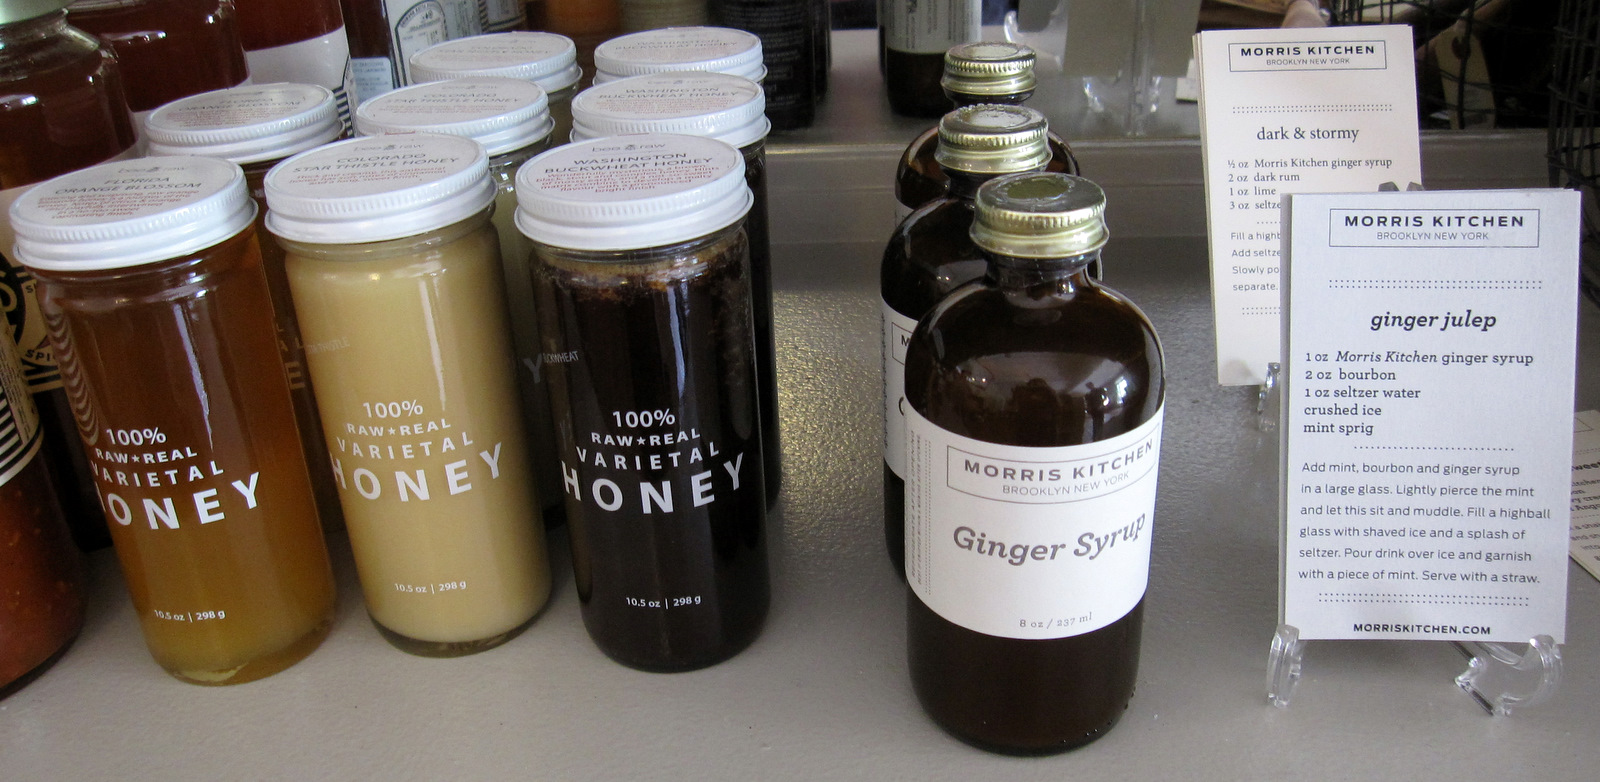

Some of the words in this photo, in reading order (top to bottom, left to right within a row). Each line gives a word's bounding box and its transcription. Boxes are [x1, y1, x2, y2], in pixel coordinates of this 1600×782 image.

[1241, 47, 1301, 56] MORRIS
[1308, 46, 1374, 55] KITCHEN
[1257, 126, 1289, 140] dark
[1293, 127, 1306, 140] &
[1310, 128, 1359, 143] stormy
[337, 154, 427, 163] COLORADO
[545, 163, 649, 173] BUCKWHEAT
[654, 157, 712, 167] HONEY
[574, 153, 687, 165] WASHINGTON
[1254, 159, 1288, 168] Morris
[1291, 157, 1328, 167] Kitchen
[1331, 158, 1362, 170] ginger
[1365, 159, 1392, 169] syrup
[293, 165, 331, 173] STAR
[337, 161, 399, 169] THISTLE
[104, 177, 169, 185] FLORIDA
[1228, 173, 1234, 182] 2
[1253, 172, 1276, 182] dark
[55, 186, 122, 194] ORANGE
[1230, 187, 1233, 196] 1
[1254, 186, 1276, 195] lime
[1230, 201, 1235, 210] 3
[1345, 216, 1423, 227] MORRIS
[1433, 216, 1523, 227] KITCHEN
[1231, 232, 1245, 240] Fill
[1377, 232, 1431, 240] BROOKLYN
[1434, 232, 1458, 240] NEW
[1461, 232, 1489, 240] YORK
[1232, 249, 1251, 257] Add
[1232, 266, 1264, 275] Slowly
[1233, 283, 1278, 292] separate.
[1370, 311, 1439, 331] ginger
[1440, 309, 1496, 332] julep
[1306, 352, 1311, 362] 1
[1315, 353, 1328, 362] oz
[1335, 350, 1381, 362] Morris
[1385, 350, 1437, 363] Kitchen
[1442, 352, 1488, 366] ginger
[1492, 355, 1534, 366] syrup
[1305, 370, 1313, 380] 2
[1316, 371, 1332, 380] oz
[1339, 367, 1396, 380] bourbon
[1305, 388, 1311, 397] 1
[1315, 389, 1330, 398] oz
[1334, 385, 1379, 398] seltzer
[1383, 388, 1421, 398] water
[363, 399, 423, 418] 100%
[1304, 403, 1358, 415] crushed
[1362, 404, 1382, 416] ice
[613, 408, 675, 428] 100%
[1303, 422, 1335, 433] mint
[1339, 422, 1374, 436] sprig
[106, 427, 166, 446] 100%
[336, 432, 473, 459] VARIETAL
[576, 442, 719, 470] VARIETAL
[964, 459, 1061, 481] MORRIS
[1072, 439, 1153, 479] KITCHEN
[90, 460, 224, 487] VARIETAL
[330, 442, 502, 502] HONEY
[1302, 462, 1326, 472] Add
[1329, 462, 1359, 473] mint,
[1363, 462, 1413, 473] bourbon
[1416, 463, 1440, 474] and
[1443, 464, 1482, 476] ginger
[1485, 466, 1520, 476] syrup
[561, 452, 744, 514] HONEY
[1002, 484, 1070, 496] BROOKLYN
[1074, 481, 1100, 493] NEW
[1104, 471, 1128, 486] YORK
[1301, 484, 1311, 493] in
[1314, 485, 1322, 494] a
[1325, 484, 1355, 496] large
[1358, 484, 1393, 496] glass.
[1396, 484, 1437, 496] Lightly
[1440, 485, 1478, 496] pierce
[1482, 486, 1502, 496] the
[1505, 487, 1534, 497] mint
[1300, 505, 1323, 515] and
[1326, 505, 1341, 515] let
[1345, 505, 1367, 515] this
[1370, 506, 1384, 516] sit
[1387, 506, 1410, 516] and
[1413, 506, 1464, 517] muddle.
[1467, 507, 1485, 517] Fill
[1489, 509, 1496, 518] a
[1500, 508, 1550, 520] highball
[953, 526, 1066, 566] Ginger
[1073, 513, 1146, 561] Syrup
[1299, 526, 1331, 538] glass
[1334, 527, 1360, 536] with
[1363, 527, 1406, 537] shaved
[1409, 528, 1426, 538] ice
[1429, 528, 1453, 538] and
[1456, 530, 1464, 538] a
[1467, 529, 1509, 540] splash
[1512, 529, 1526, 540] of
[1299, 548, 1341, 558] seltzer.
[1344, 548, 1372, 558] Pour
[1375, 548, 1405, 558] drink
[1408, 551, 1434, 559] over
[1438, 549, 1455, 559] ice
[1458, 550, 1482, 560] and
[1485, 551, 1532, 562] garnish
[1298, 569, 1324, 579] with
[1327, 571, 1334, 579] a
[1337, 570, 1369, 582] piece
[1372, 569, 1385, 580] of
[1388, 570, 1418, 580] mint.
[1422, 570, 1457, 581] Serve
[1460, 572, 1487, 582] with
[1490, 574, 1498, 582] a
[1502, 573, 1540, 583] straw.
[395, 583, 413, 592] 10.5
[439, 581, 458, 591] 298
[459, 581, 466, 590] g
[626, 597, 646, 607] 10.5
[673, 596, 692, 606] 298
[694, 595, 701, 605] g
[154, 609, 172, 620] 10.5
[196, 611, 216, 620] 298
[218, 610, 225, 619] g
[1019, 619, 1026, 628] 8
[1056, 617, 1075, 627] 237
[1079, 611, 1092, 623] ml
[1353, 623, 1490, 635] MORRISKITCHEN.COM
